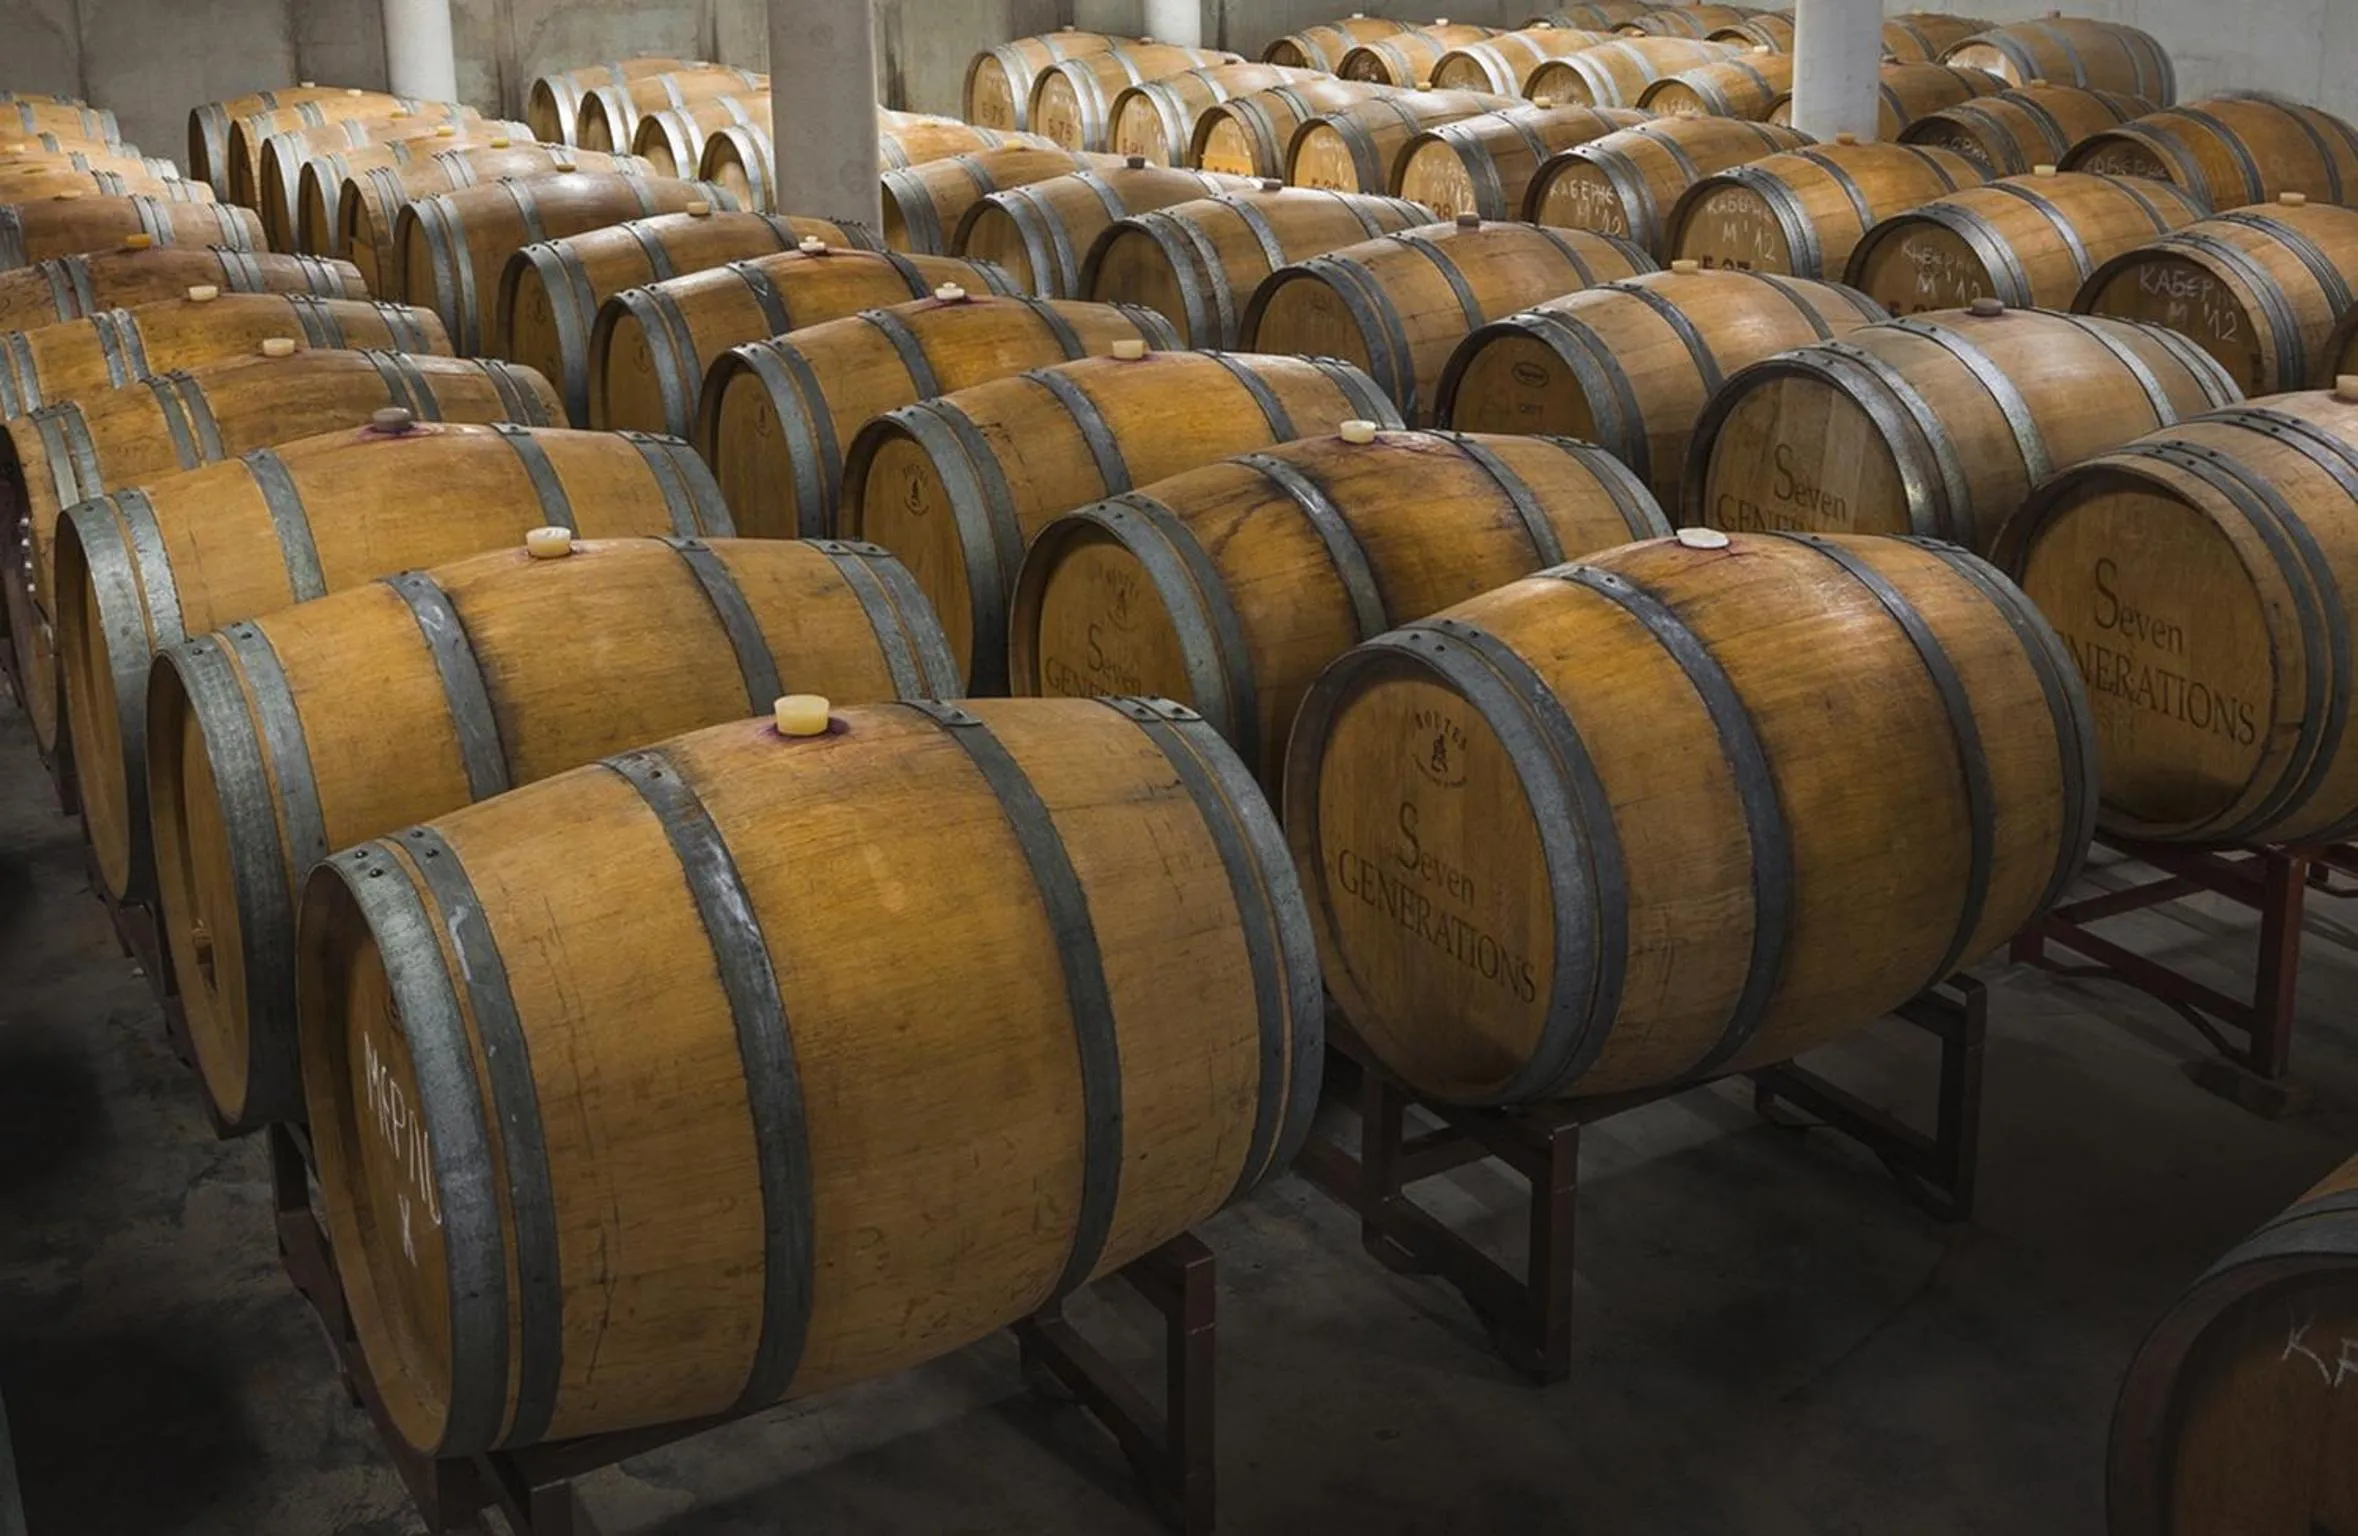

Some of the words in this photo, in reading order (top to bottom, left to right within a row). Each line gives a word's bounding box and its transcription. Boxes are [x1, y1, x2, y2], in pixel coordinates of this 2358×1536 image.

[1774, 443, 1847, 523] Seven
[2094, 557, 2184, 655] Seven
[2055, 629, 2256, 746] NERATIONS
[1398, 801, 1475, 909] Seven
[1338, 849, 1536, 1004] GENERATIONS
